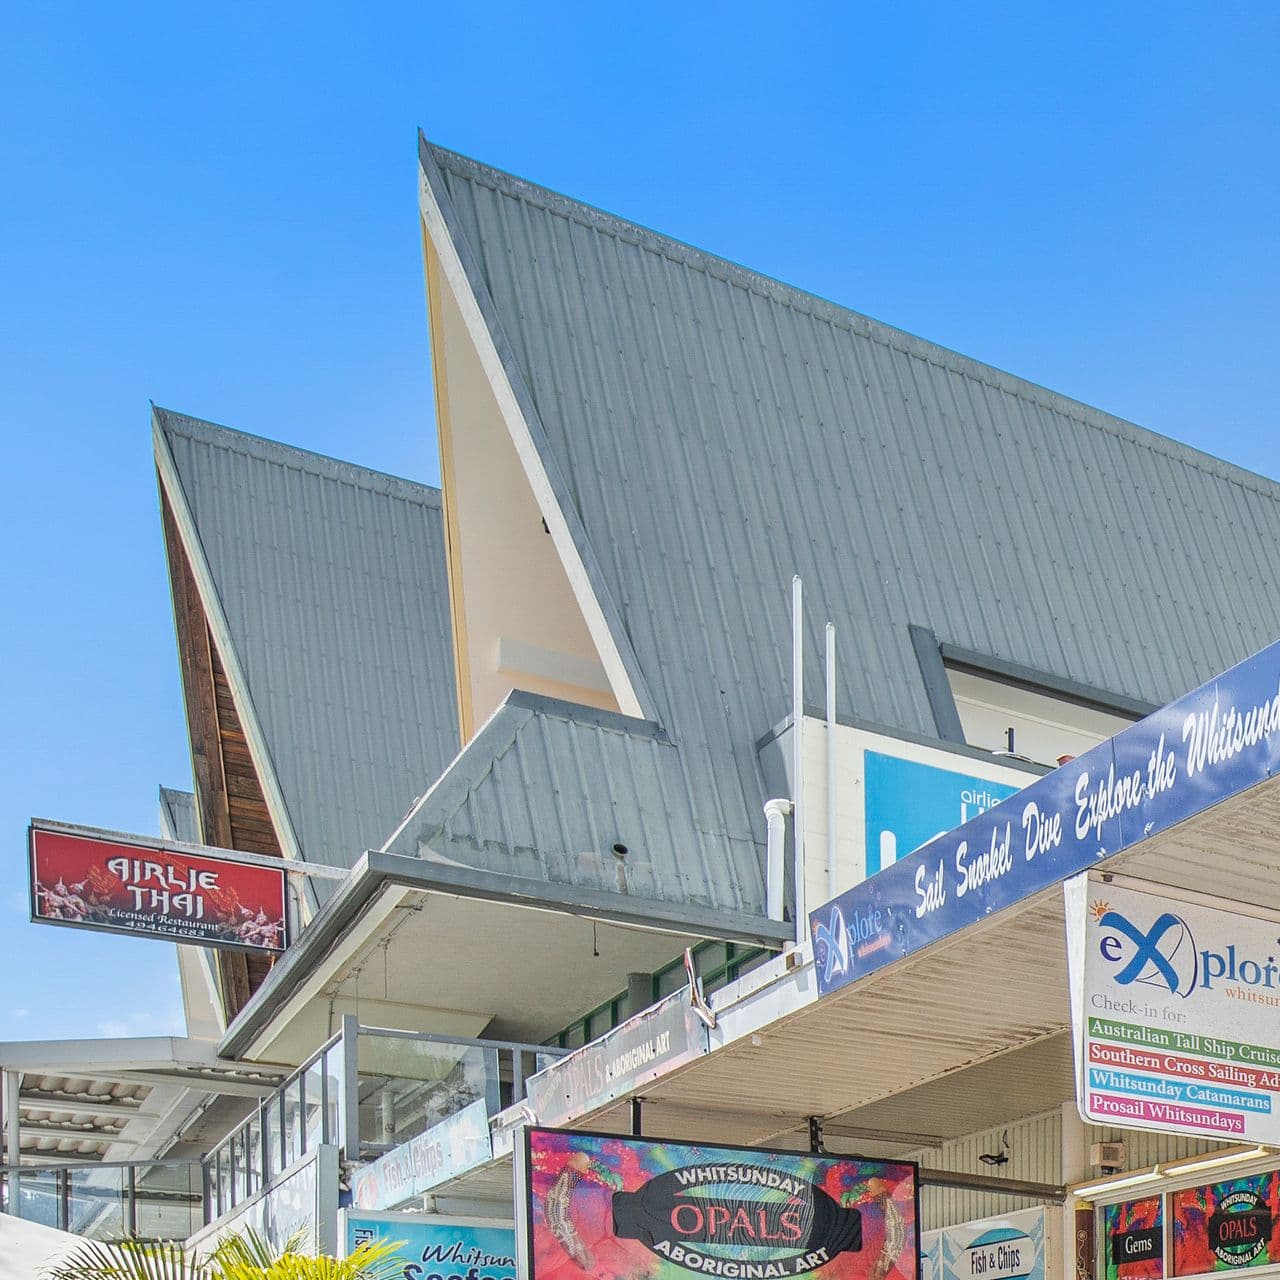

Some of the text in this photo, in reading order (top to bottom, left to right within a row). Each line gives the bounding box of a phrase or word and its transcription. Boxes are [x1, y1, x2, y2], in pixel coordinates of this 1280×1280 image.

[915, 859, 945, 918] Sail
[956, 820, 1012, 898] Snorkel
[1023, 801, 1062, 861] Dive
[1075, 772, 1143, 842] Explore
[1146, 732, 1177, 796] the
[107, 857, 220, 891] AIRLIE
[127, 885, 204, 919] THAI
[108, 908, 218, 931] Licensed Restaurant
[1091, 993, 1187, 1023] Check-in for:
[612, 1031, 670, 1078] ABORIGINAL ART
[1092, 1019, 1168, 1045] Australian
[1174, 1033, 1201, 1051] Tall
[1204, 1039, 1235, 1059] Ship
[1091, 1045, 1160, 1070] Southern
[1164, 1057, 1205, 1076] Cross
[1208, 1064, 1256, 1087] Sailing
[1093, 1070, 1270, 1110] Whitsunday Catamarans
[1093, 1096, 1242, 1130] Prosail Whitsundays
[674, 1167, 805, 1196] WHITSUNDAY
[1220, 1192, 1257, 1211] WHITSUNDAY
[671, 1205, 801, 1241] OPALS
[1219, 1219, 1257, 1240] OPALS
[653, 1240, 829, 1278] ABORIGINAL ART
[971, 1245, 1020, 1274] Fish & Chips
[1125, 1236, 1152, 1254] Gems
[1214, 1238, 1266, 1265] ABORIGINAL ART
